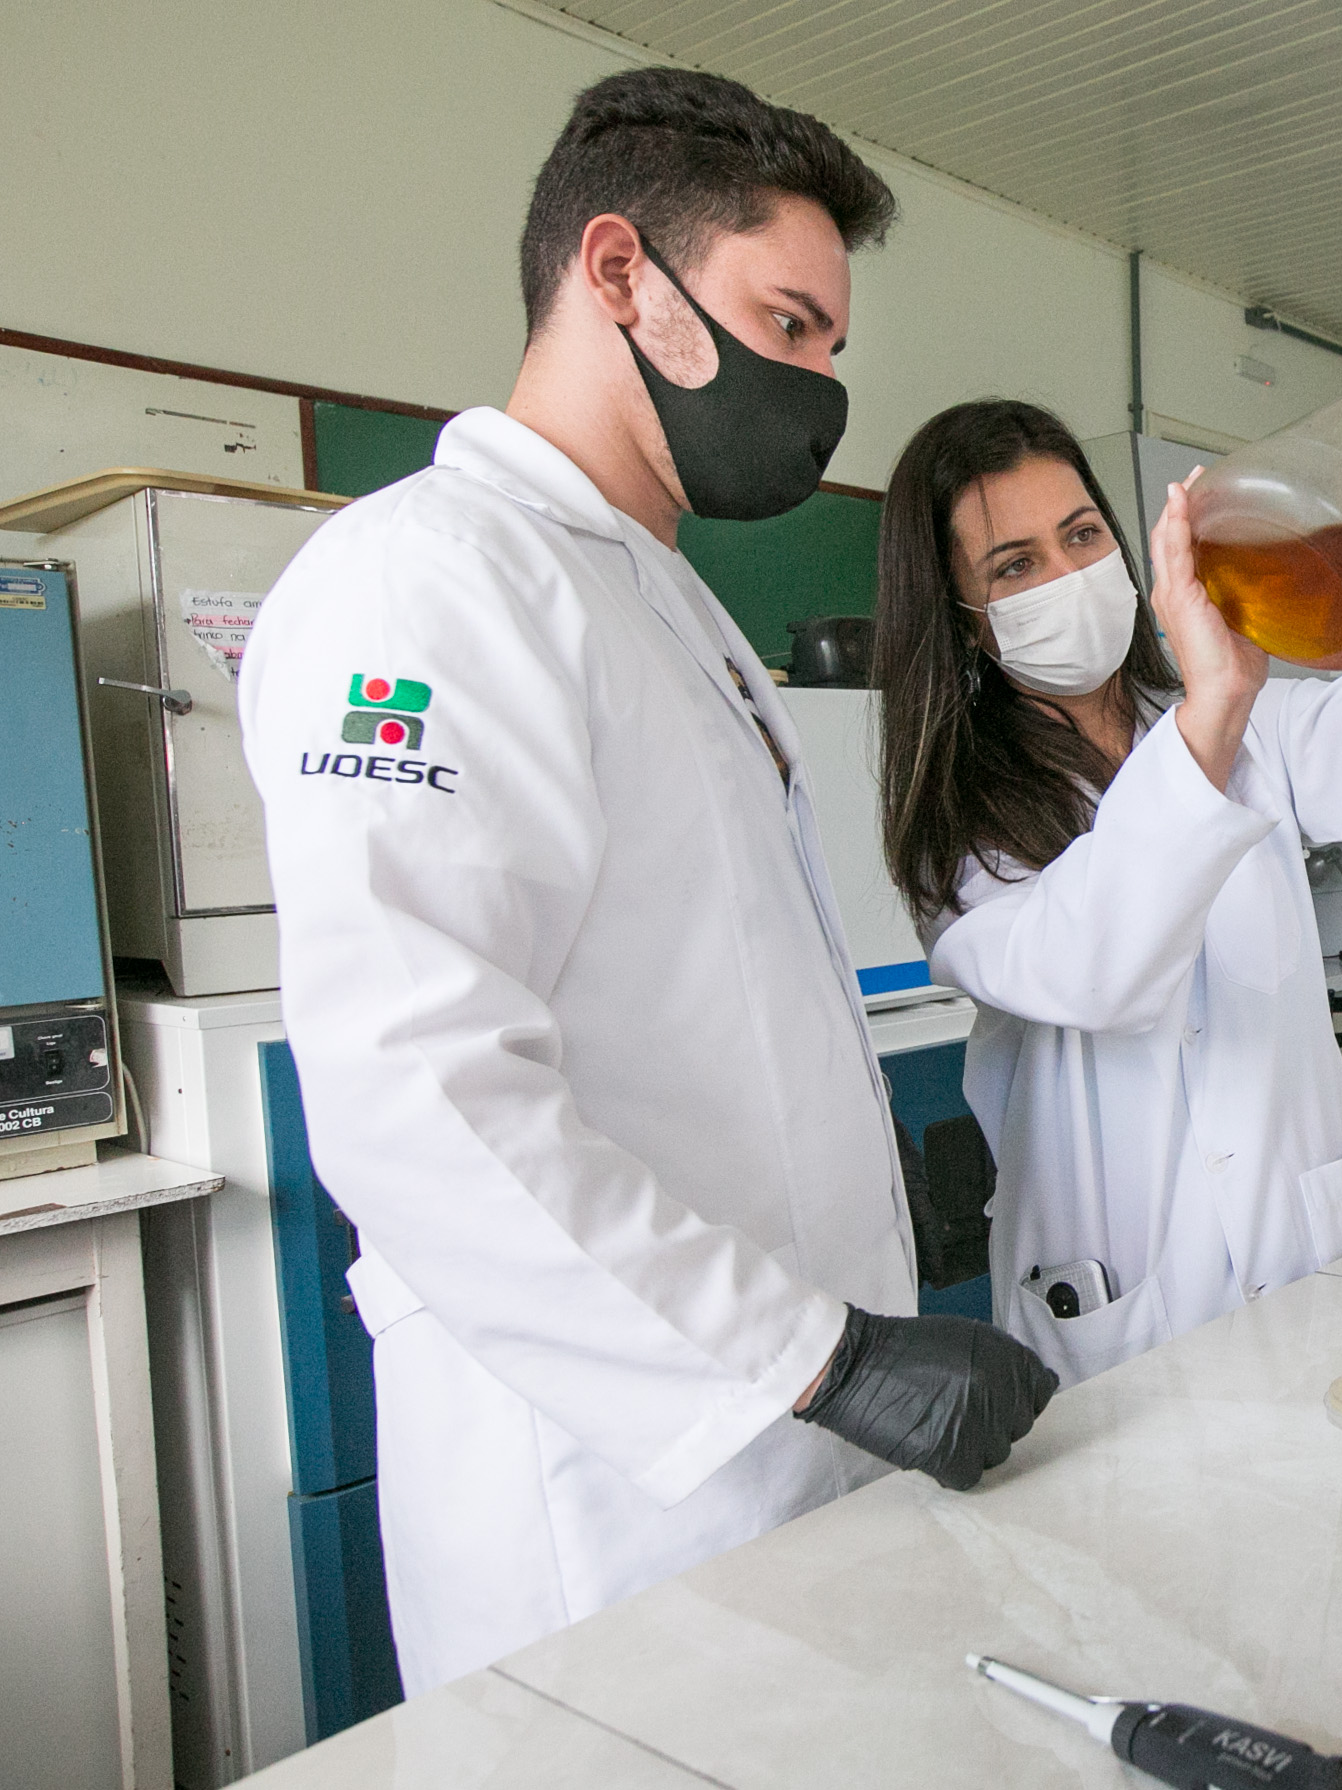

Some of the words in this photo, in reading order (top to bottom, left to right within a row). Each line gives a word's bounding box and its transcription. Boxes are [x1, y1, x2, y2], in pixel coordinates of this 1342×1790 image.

[191, 596, 233, 607] Estufa
[190, 613, 213, 626] Para
[301, 752, 459, 794] UDESC
[8, 1105, 55, 1119] Cultura
[22, 1117, 42, 1128] CB
[1212, 1729, 1293, 1772] KASVI
